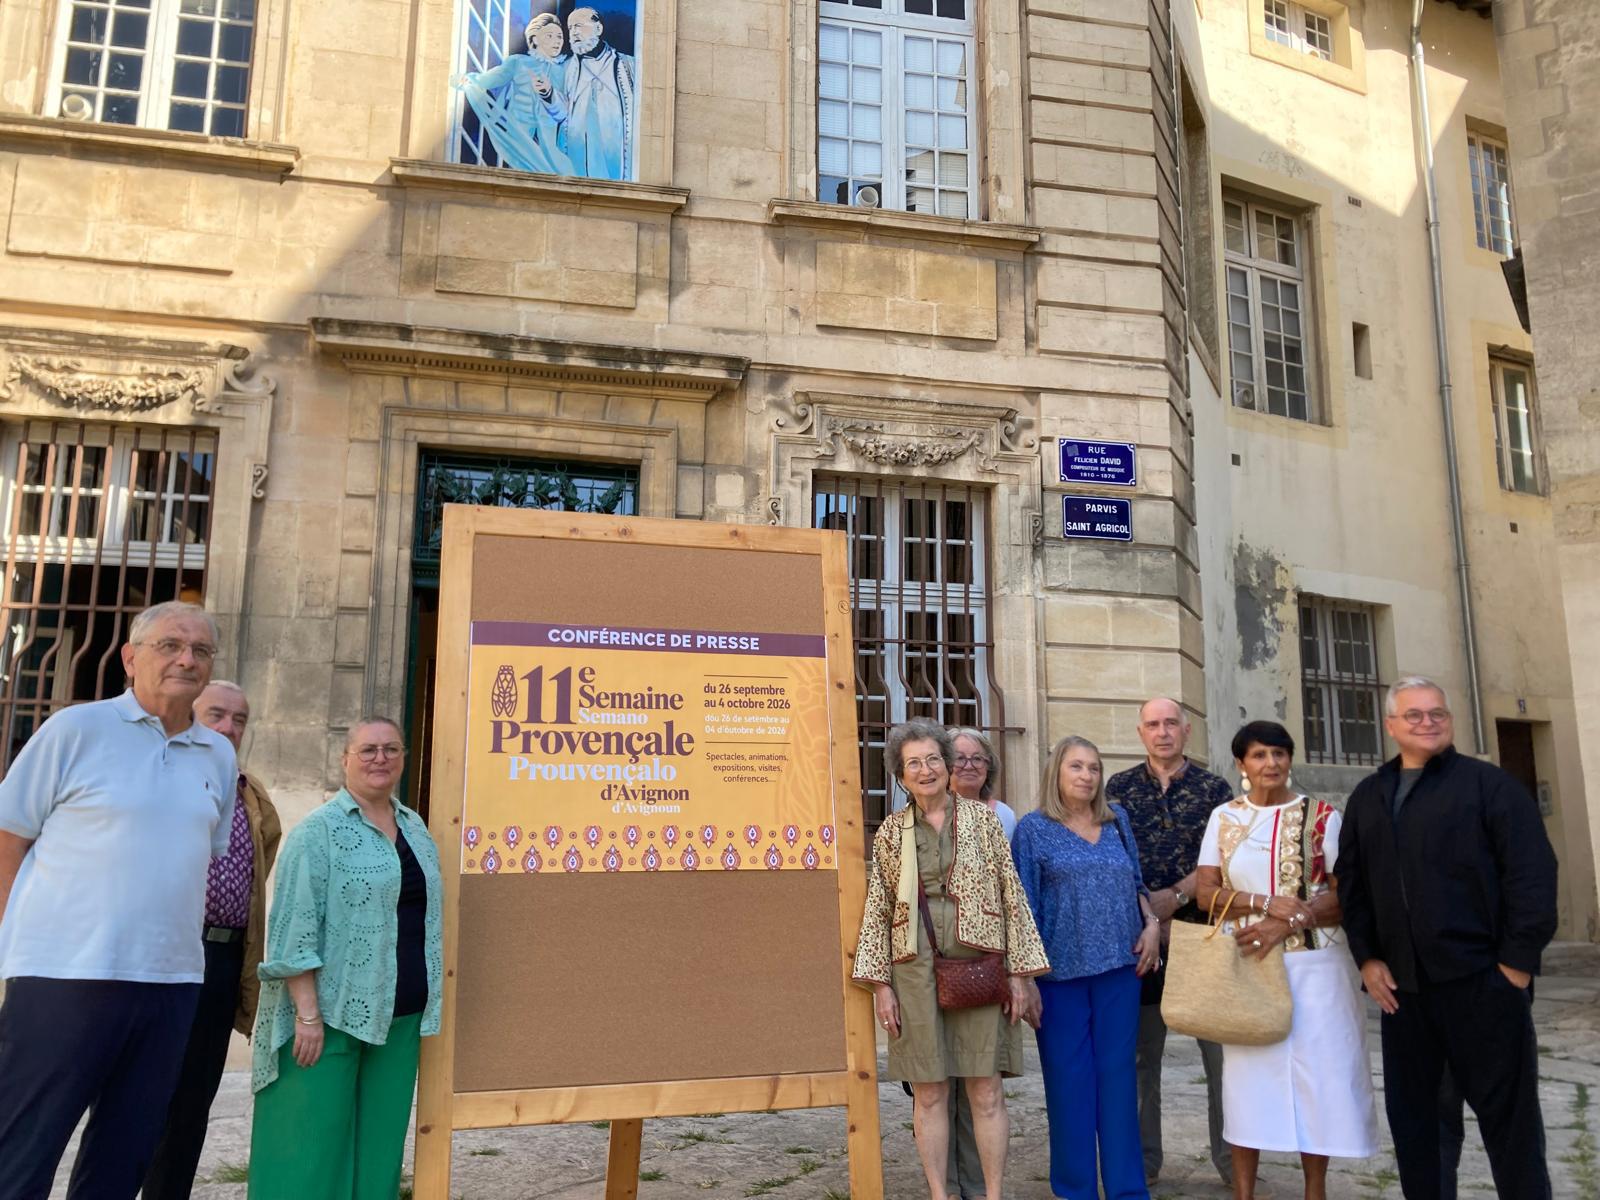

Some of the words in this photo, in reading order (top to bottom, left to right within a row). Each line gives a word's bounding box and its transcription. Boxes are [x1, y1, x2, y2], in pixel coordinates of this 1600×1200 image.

[1088, 446, 1106, 454] RUE
[1100, 457, 1121, 465] DAVID
[1085, 503, 1118, 514] PARVIS
[1066, 522, 1091, 532] SAINT
[1095, 523, 1130, 534] AGRICOL
[547, 627, 666, 647] CONFÉRENCE
[670, 634, 692, 648] DE
[696, 635, 760, 651] PRESSE
[704, 683, 716, 694] du
[719, 683, 731, 694] 26
[733, 684, 785, 697] septembre
[578, 684, 684, 710] Semaine
[704, 699, 716, 708] au
[718, 698, 725, 708] 4
[727, 698, 765, 709] octobre
[767, 699, 791, 709] 2026
[578, 708, 649, 725] Semano
[721, 714, 731, 723] 26
[733, 714, 742, 723] de
[704, 725, 715, 734] 04
[755, 726, 766, 735] de
[767, 726, 786, 736] 2026
[488, 719, 695, 764] Provençale
[706, 752, 747, 762] Spectacles,
[748, 753, 789, 762] animations,
[508, 756, 677, 785] Prouvençalo
[713, 765, 757, 774] expositions,
[758, 765, 783, 773] visites,
[600, 784, 690, 805] d'Avignon
[612, 802, 681, 816] d'Avignoun
